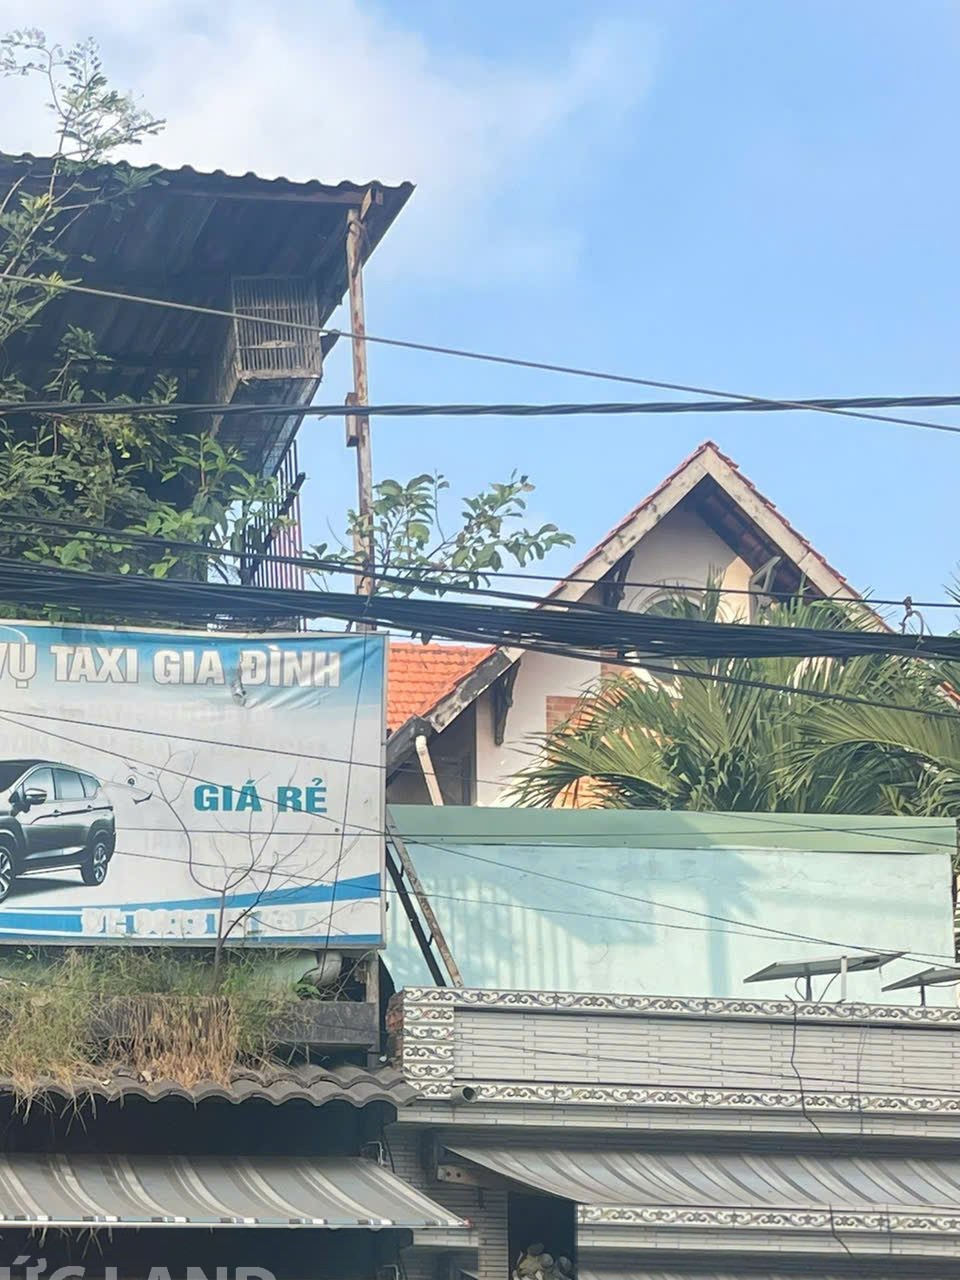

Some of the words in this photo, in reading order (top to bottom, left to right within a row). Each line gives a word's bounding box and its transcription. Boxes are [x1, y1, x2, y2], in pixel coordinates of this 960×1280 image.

[49, 643, 140, 684] TAXI
[152, 649, 226, 686] GIA
[239, 643, 341, 688] ĐÌNH
[193, 779, 263, 813] GIÁ
[277, 777, 328, 814] RẺ
